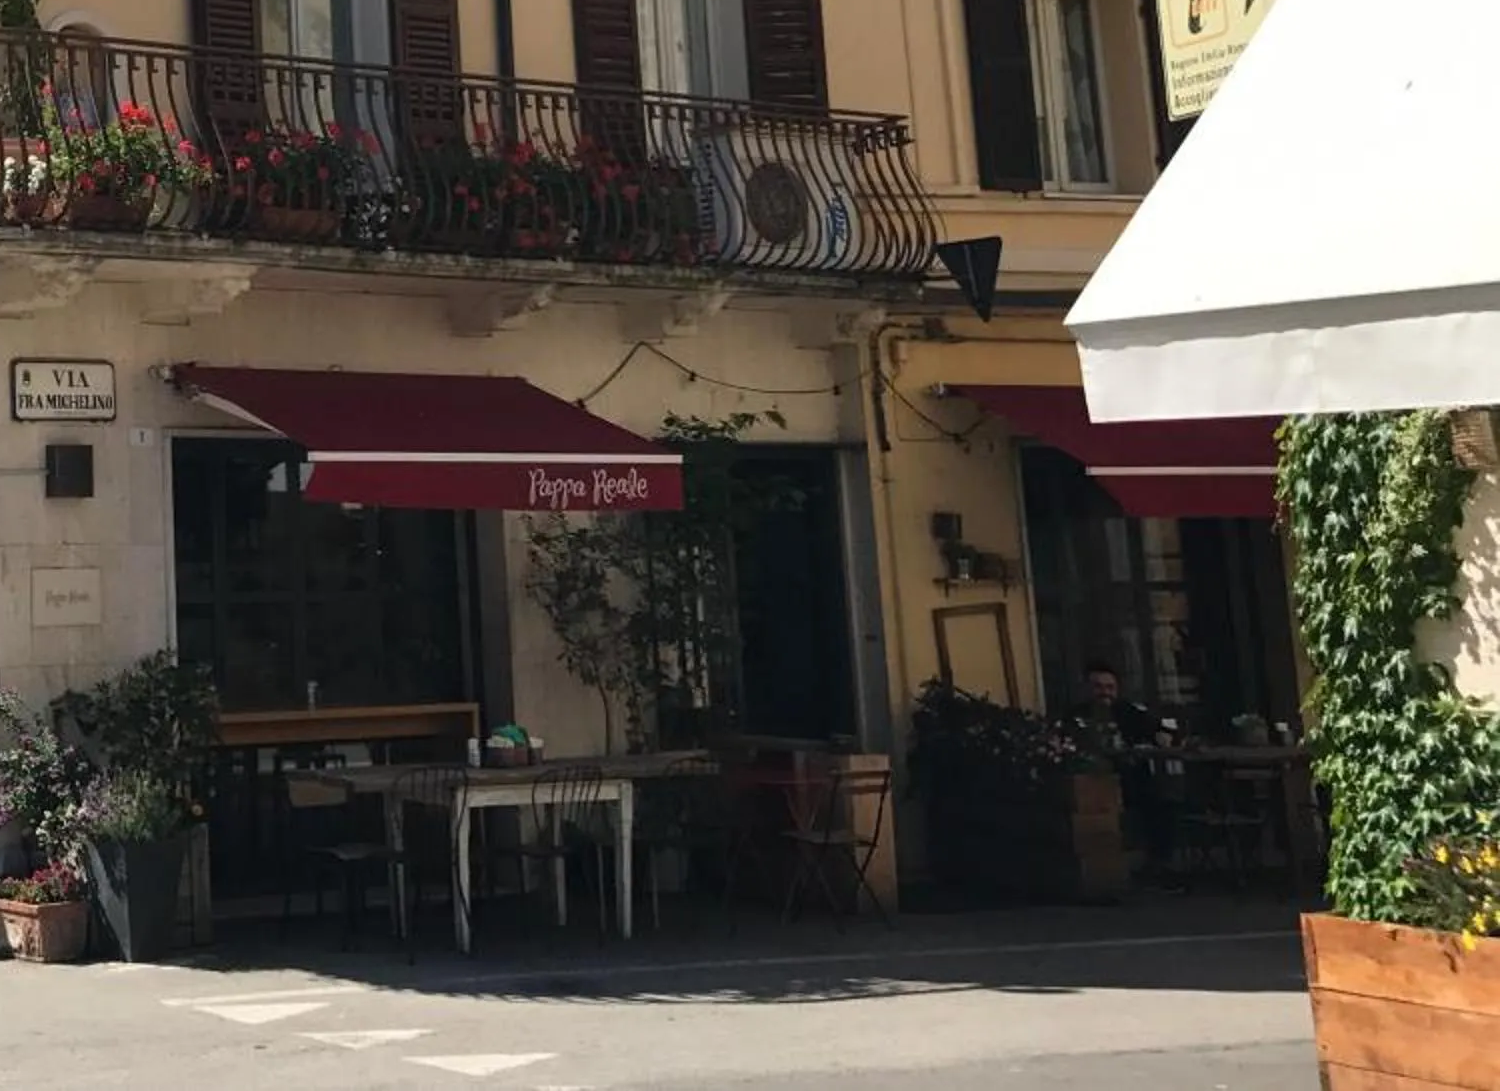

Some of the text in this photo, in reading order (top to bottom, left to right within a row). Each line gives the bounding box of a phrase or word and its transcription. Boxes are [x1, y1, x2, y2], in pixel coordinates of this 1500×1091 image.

[52, 368, 90, 388] VIA
[18, 393, 113, 410] FRA MICHELINO
[528, 465, 650, 510] Pappa Reale
